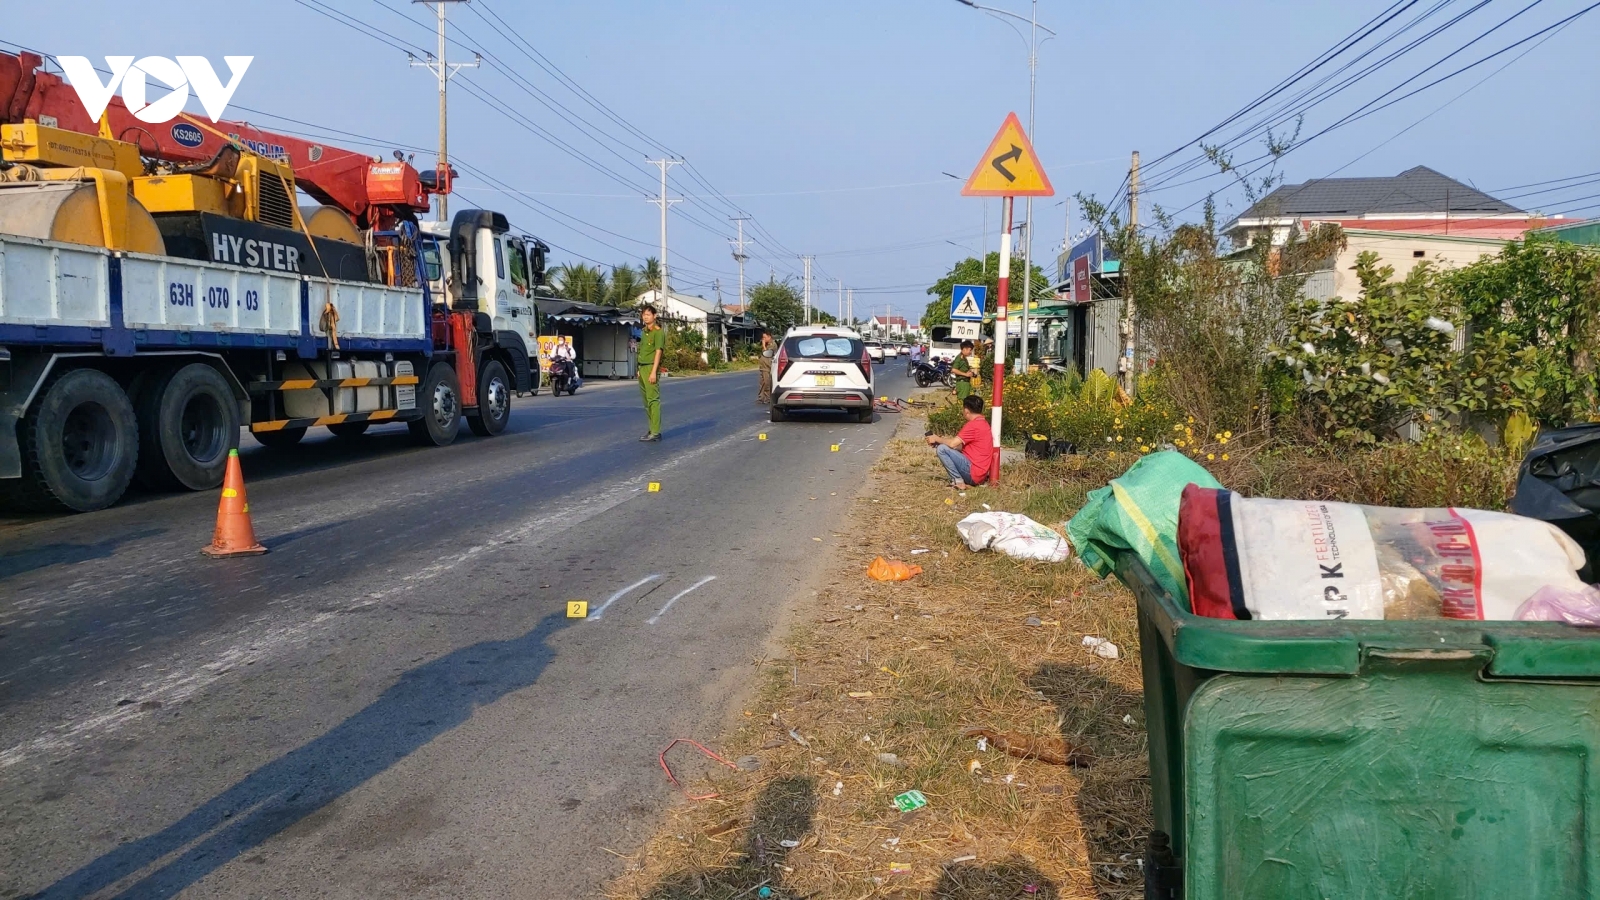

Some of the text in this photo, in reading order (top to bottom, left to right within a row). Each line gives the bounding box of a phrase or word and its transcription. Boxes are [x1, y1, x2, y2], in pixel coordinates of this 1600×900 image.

[173, 128, 202, 143] KS2605
[212, 232, 300, 272] HYSTER
[957, 325, 966, 335] 70
[1320, 504, 1329, 513] USA
[1305, 504, 1330, 561] FERTILIZER
[1326, 519, 1340, 560] TECHNOLOGY
[573, 603, 581, 614] 2
